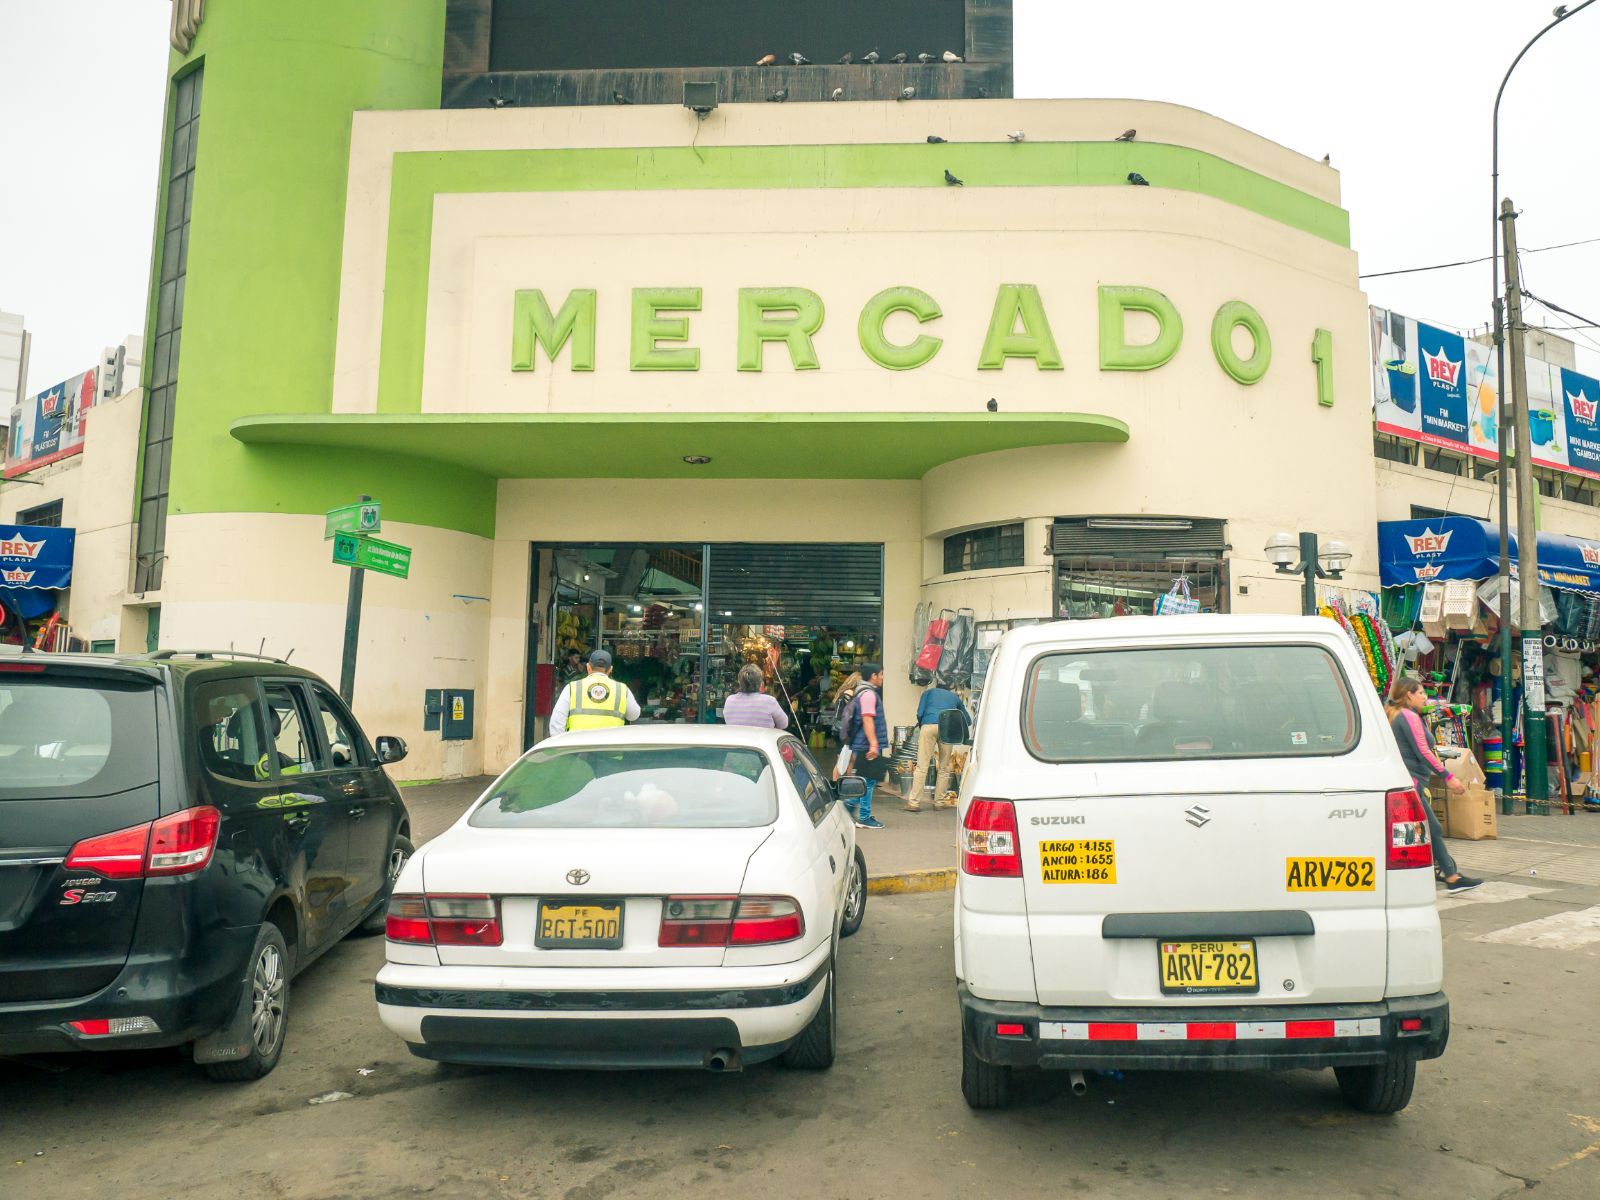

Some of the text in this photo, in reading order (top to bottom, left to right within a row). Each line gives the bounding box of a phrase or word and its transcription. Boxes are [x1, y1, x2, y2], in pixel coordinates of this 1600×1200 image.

[511, 283, 1334, 408] MERCADO 1
[1429, 357, 1457, 385] REY
[1432, 381, 1454, 393] PLAST
[1439, 407, 1449, 418] FM
[1573, 398, 1595, 420] REY
[1581, 439, 1600, 452] MARKE
[1, 541, 38, 556] REY
[1413, 536, 1446, 553] REY
[1415, 552, 1442, 560] PLAST
[1583, 549, 1599, 563] REY
[7, 572, 31, 581] REY
[1418, 568, 1439, 577] REY
[1327, 808, 1368, 819] APV
[1030, 815, 1085, 826] SUZUKI
[1042, 842, 1075, 852] LARGO
[1288, 860, 1374, 888] ARV-782
[542, 918, 617, 939] BGT-500
[1190, 942, 1224, 953] PERU
[1166, 953, 1253, 981] ARV-782
